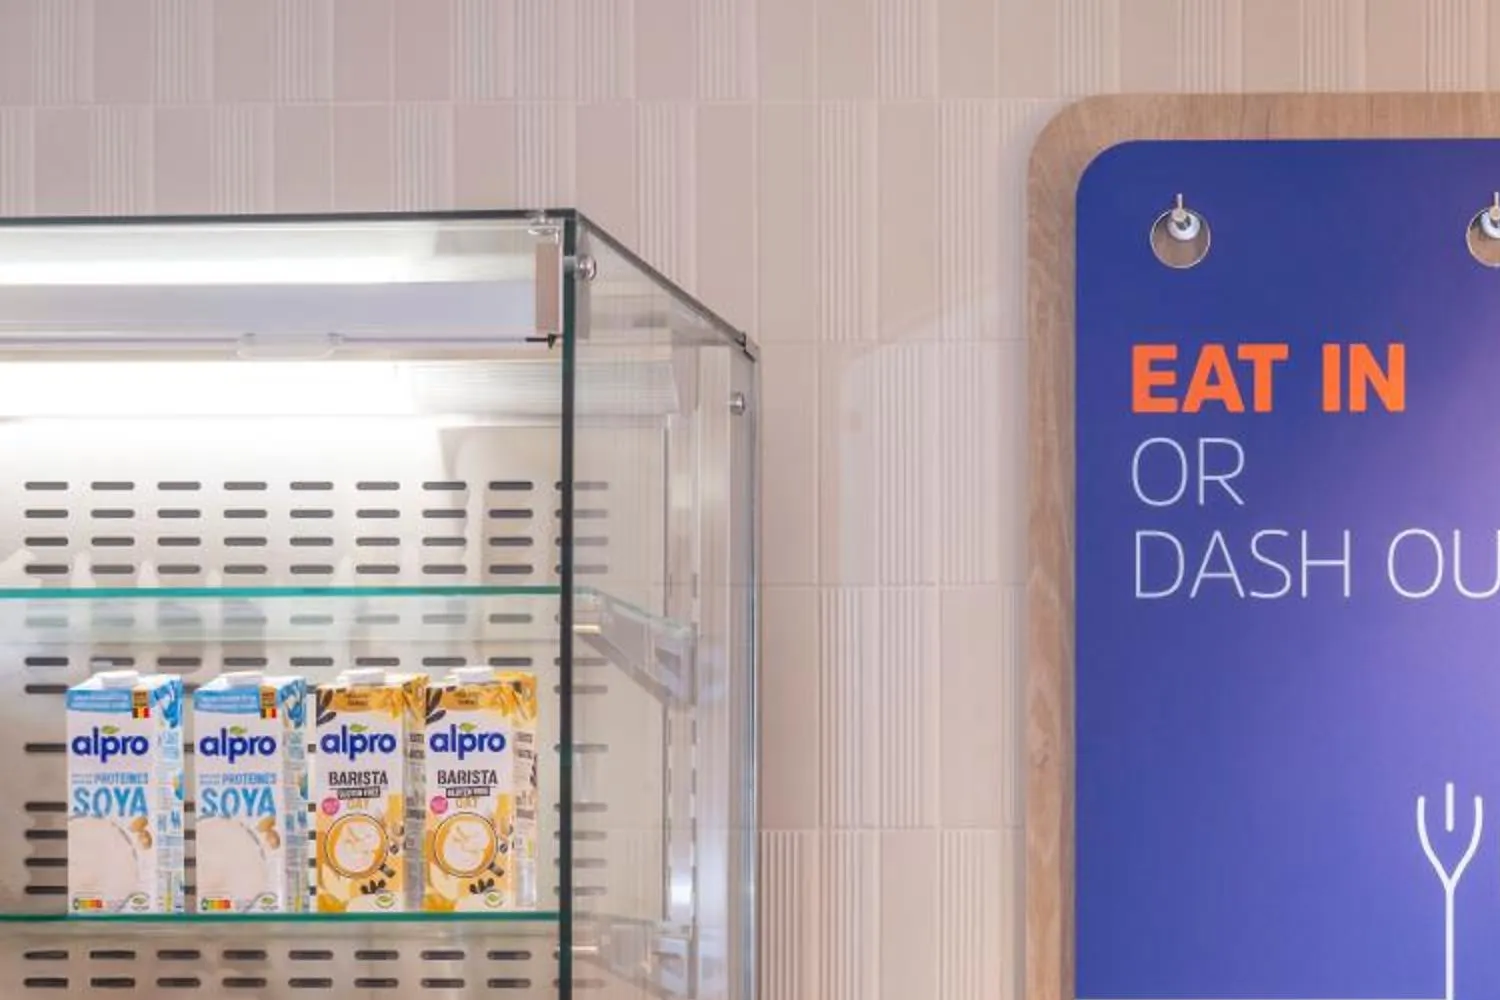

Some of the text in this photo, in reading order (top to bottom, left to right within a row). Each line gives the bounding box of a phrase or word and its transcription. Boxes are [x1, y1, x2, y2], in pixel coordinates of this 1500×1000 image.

[1131, 343, 1406, 413] EAT IN
[1132, 436, 1245, 506] OR
[1135, 529, 1350, 599] DASH
[71, 726, 149, 763] alpro
[199, 727, 277, 764] alpro
[320, 725, 397, 761] alpro
[429, 724, 506, 760] alpro
[329, 771, 388, 786] BARISTA
[437, 770, 498, 785] BARISTA
[73, 786, 149, 817] SOYA
[201, 786, 277, 817] SOYA
